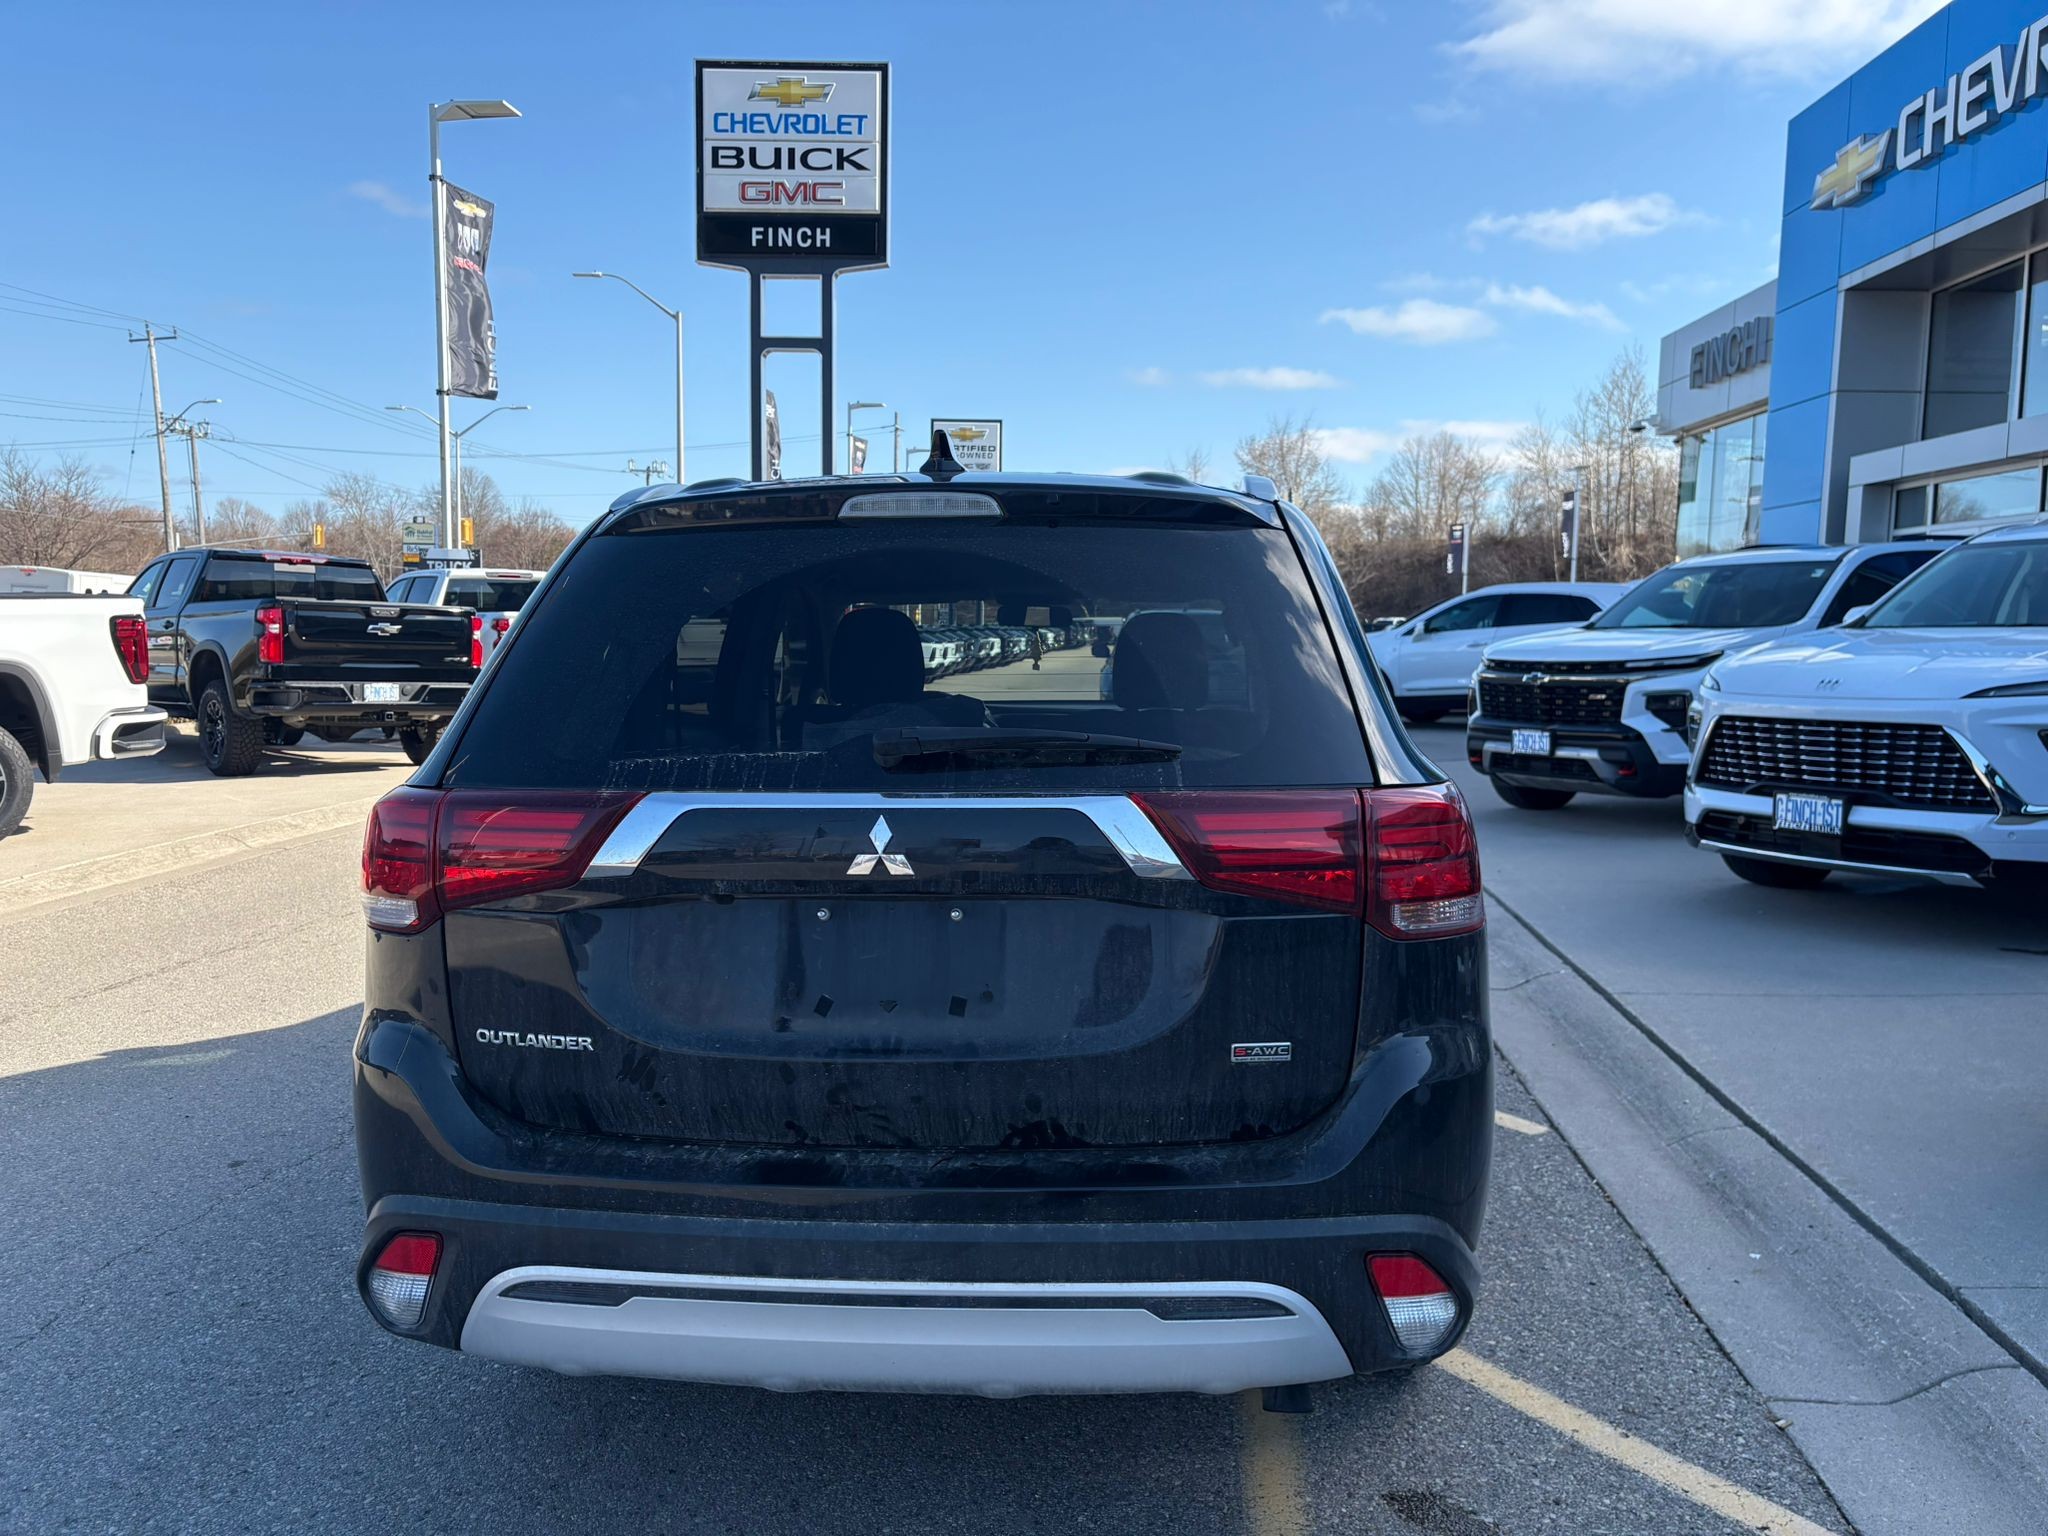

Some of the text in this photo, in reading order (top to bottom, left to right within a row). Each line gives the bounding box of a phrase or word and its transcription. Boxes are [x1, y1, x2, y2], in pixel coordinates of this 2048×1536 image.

[713, 112, 868, 135] CHEVROLET
[711, 146, 871, 171] BUICK
[738, 180, 846, 206] GMC
[751, 227, 831, 248] FINCH
[1689, 316, 1768, 389] FINCH
[953, 444, 996, 452] RTIFIED
[427, 560, 472, 569] TRUCK
[476, 1028, 594, 1051] OUTLANDER
[1234, 1046, 1289, 1057] S-AWC
